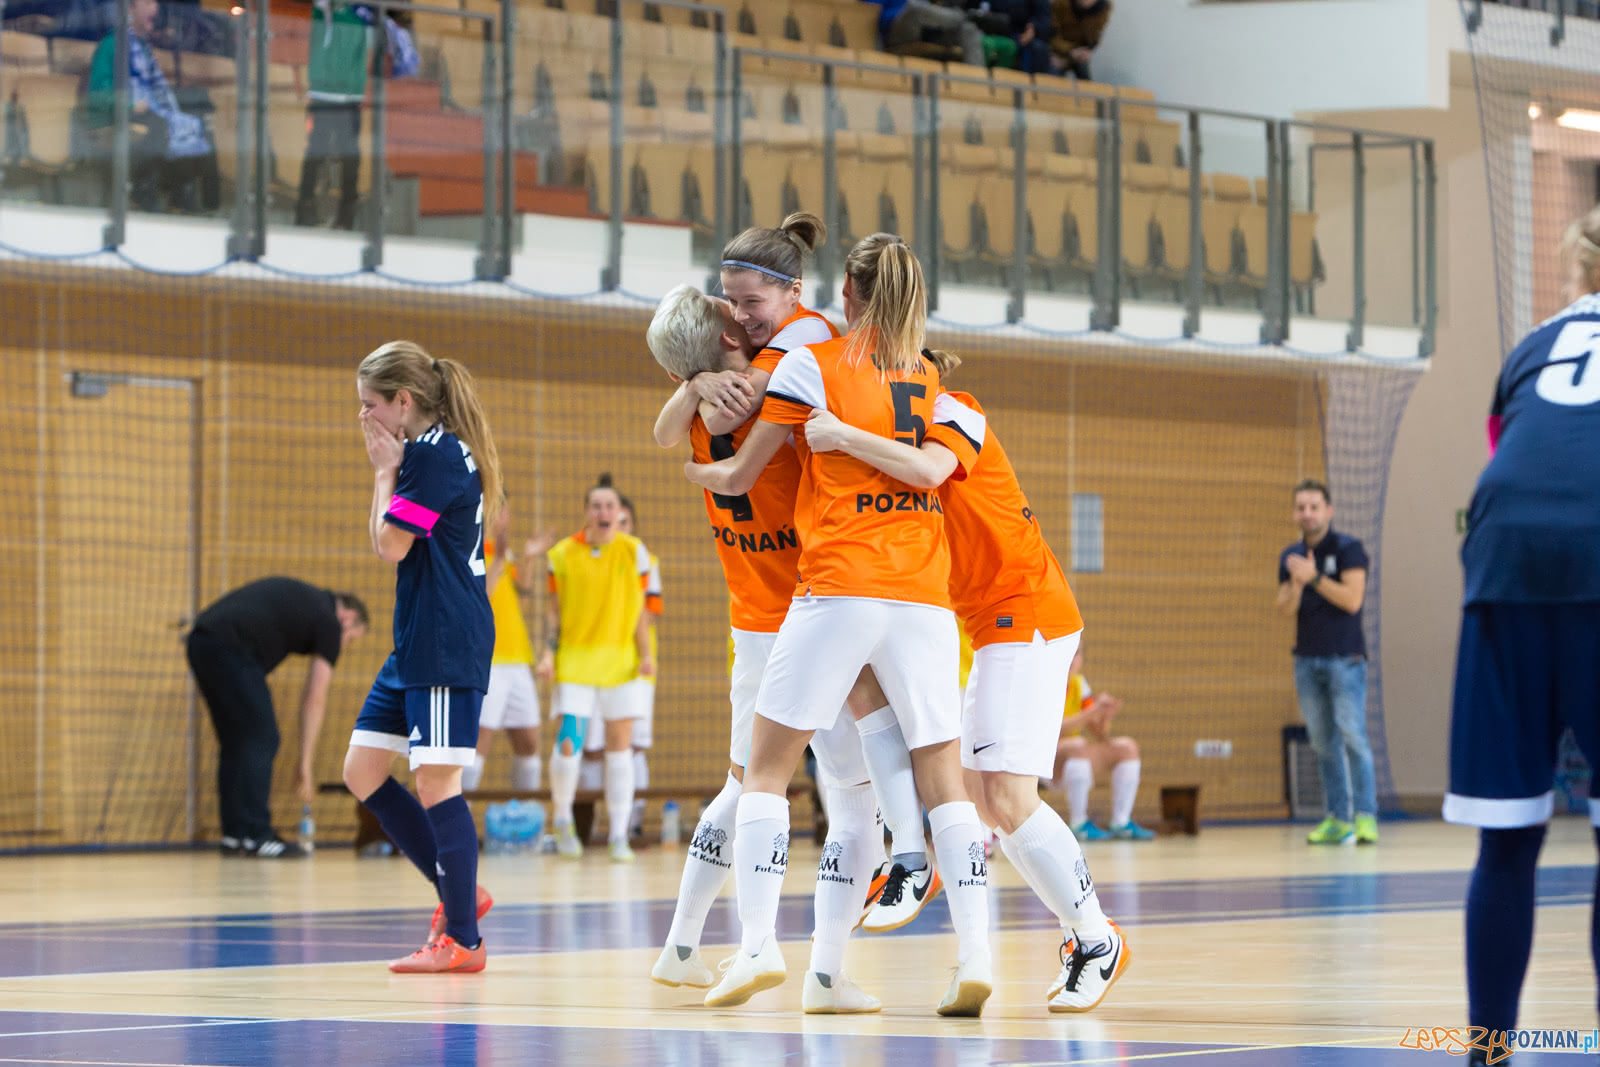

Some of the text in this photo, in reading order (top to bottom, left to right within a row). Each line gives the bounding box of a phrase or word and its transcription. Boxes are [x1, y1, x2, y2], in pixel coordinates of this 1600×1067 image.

[1535, 320, 1600, 406] 5
[889, 381, 926, 450] 5
[856, 491, 943, 514] POZNA
[711, 524, 798, 553] PONAŃ
[821, 873, 855, 887] Kobiet
